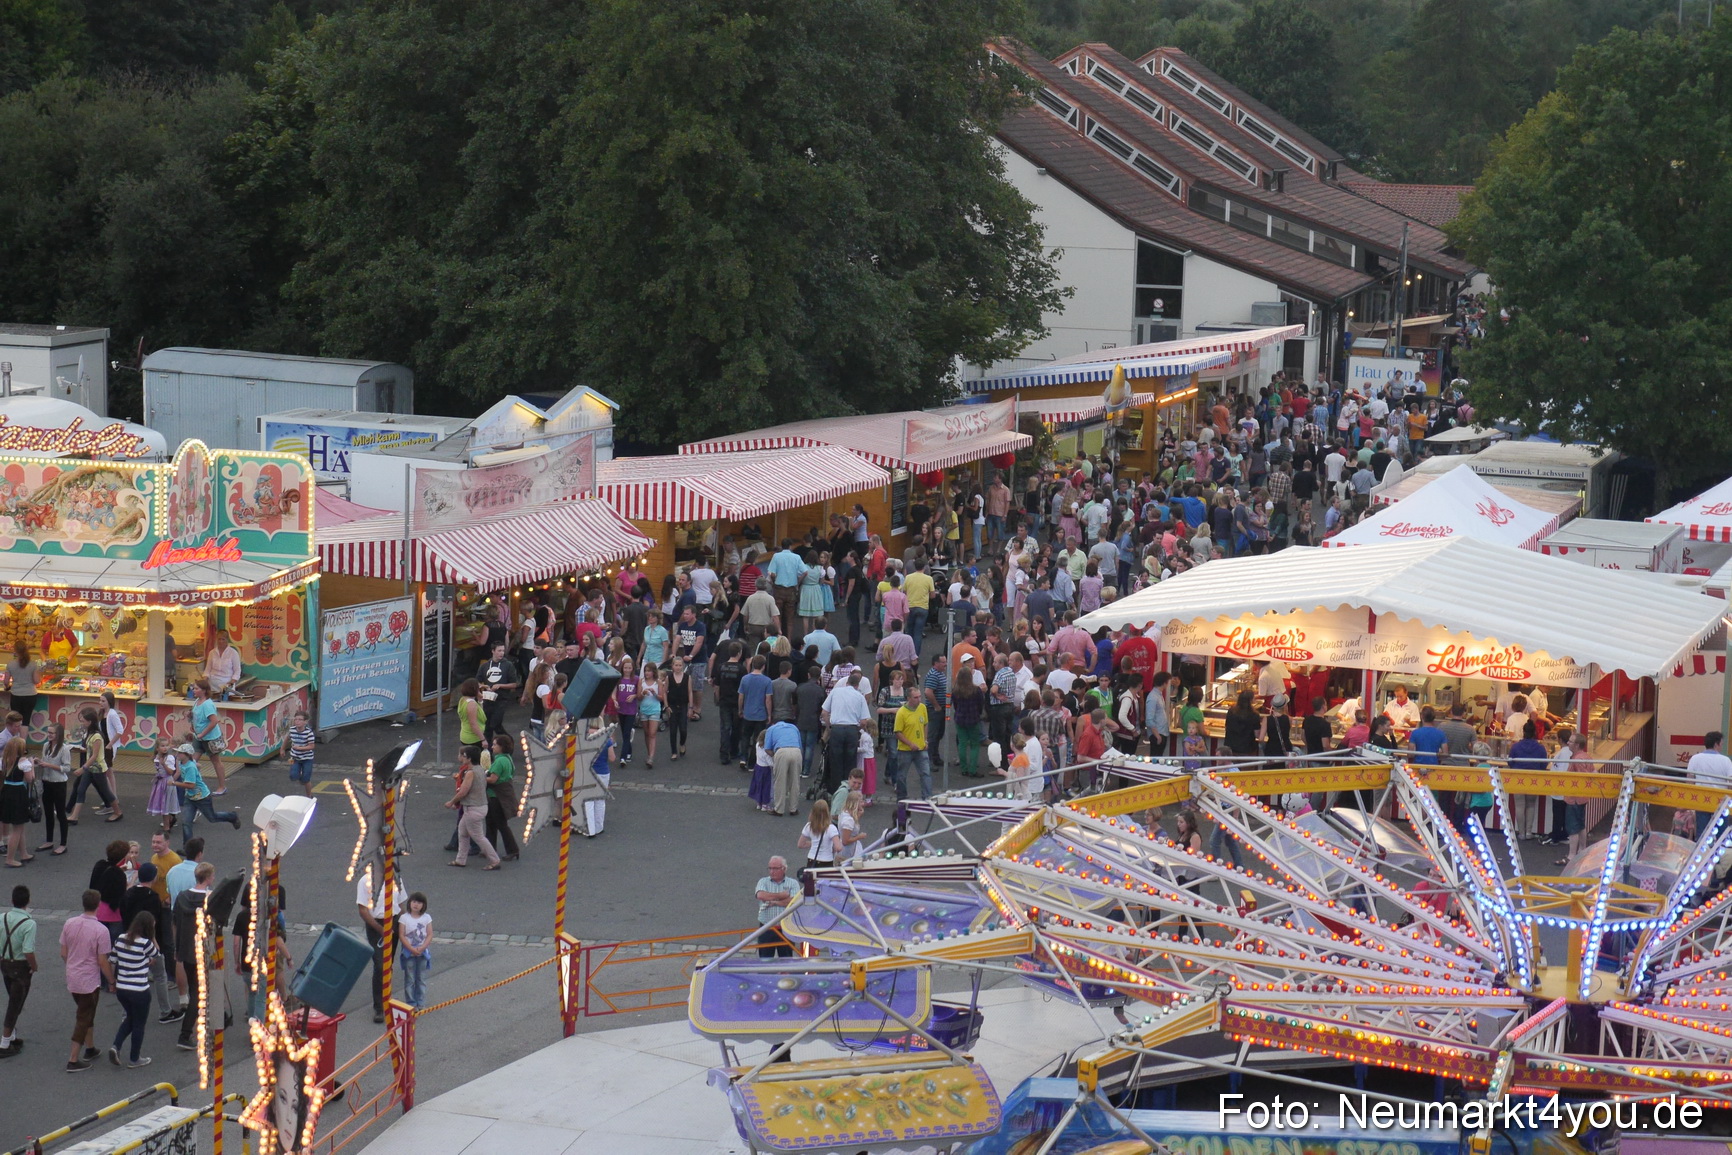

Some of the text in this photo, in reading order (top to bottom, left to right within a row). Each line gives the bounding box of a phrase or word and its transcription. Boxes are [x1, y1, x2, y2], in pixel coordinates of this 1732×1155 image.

[1355, 365, 1413, 381] Hau dn
[0, 414, 151, 458] andeln
[352, 432, 400, 447] Mich kann
[1536, 469, 1585, 478] Lachssemmel
[140, 537, 242, 570] Mandeln
[1, 586, 68, 598] KUCHEN
[79, 590, 147, 603] HERZEN
[169, 588, 245, 603] POPCORN
[260, 565, 313, 593] COCOSMAKRONEN
[1163, 624, 1197, 636] Seit über
[1182, 636, 1208, 647] Jahren
[1316, 635, 1362, 650] Genuss und
[1373, 641, 1408, 654] Seit über
[1271, 648, 1308, 660] IMBISS
[1330, 649, 1366, 663] Qualität!
[1380, 654, 1420, 667] 50 Jahren
[333, 658, 399, 675] Wir freuen uns
[1533, 658, 1562, 668] Genuss
[324, 678, 340, 686] auf
[342, 673, 367, 683] Ihren
[368, 666, 400, 678] Besuch
[1486, 666, 1525, 679] IMBISS
[1548, 668, 1587, 681] Qualität!
[333, 686, 396, 713] Fam. Hartmann
[343, 700, 384, 718] Wunderle
